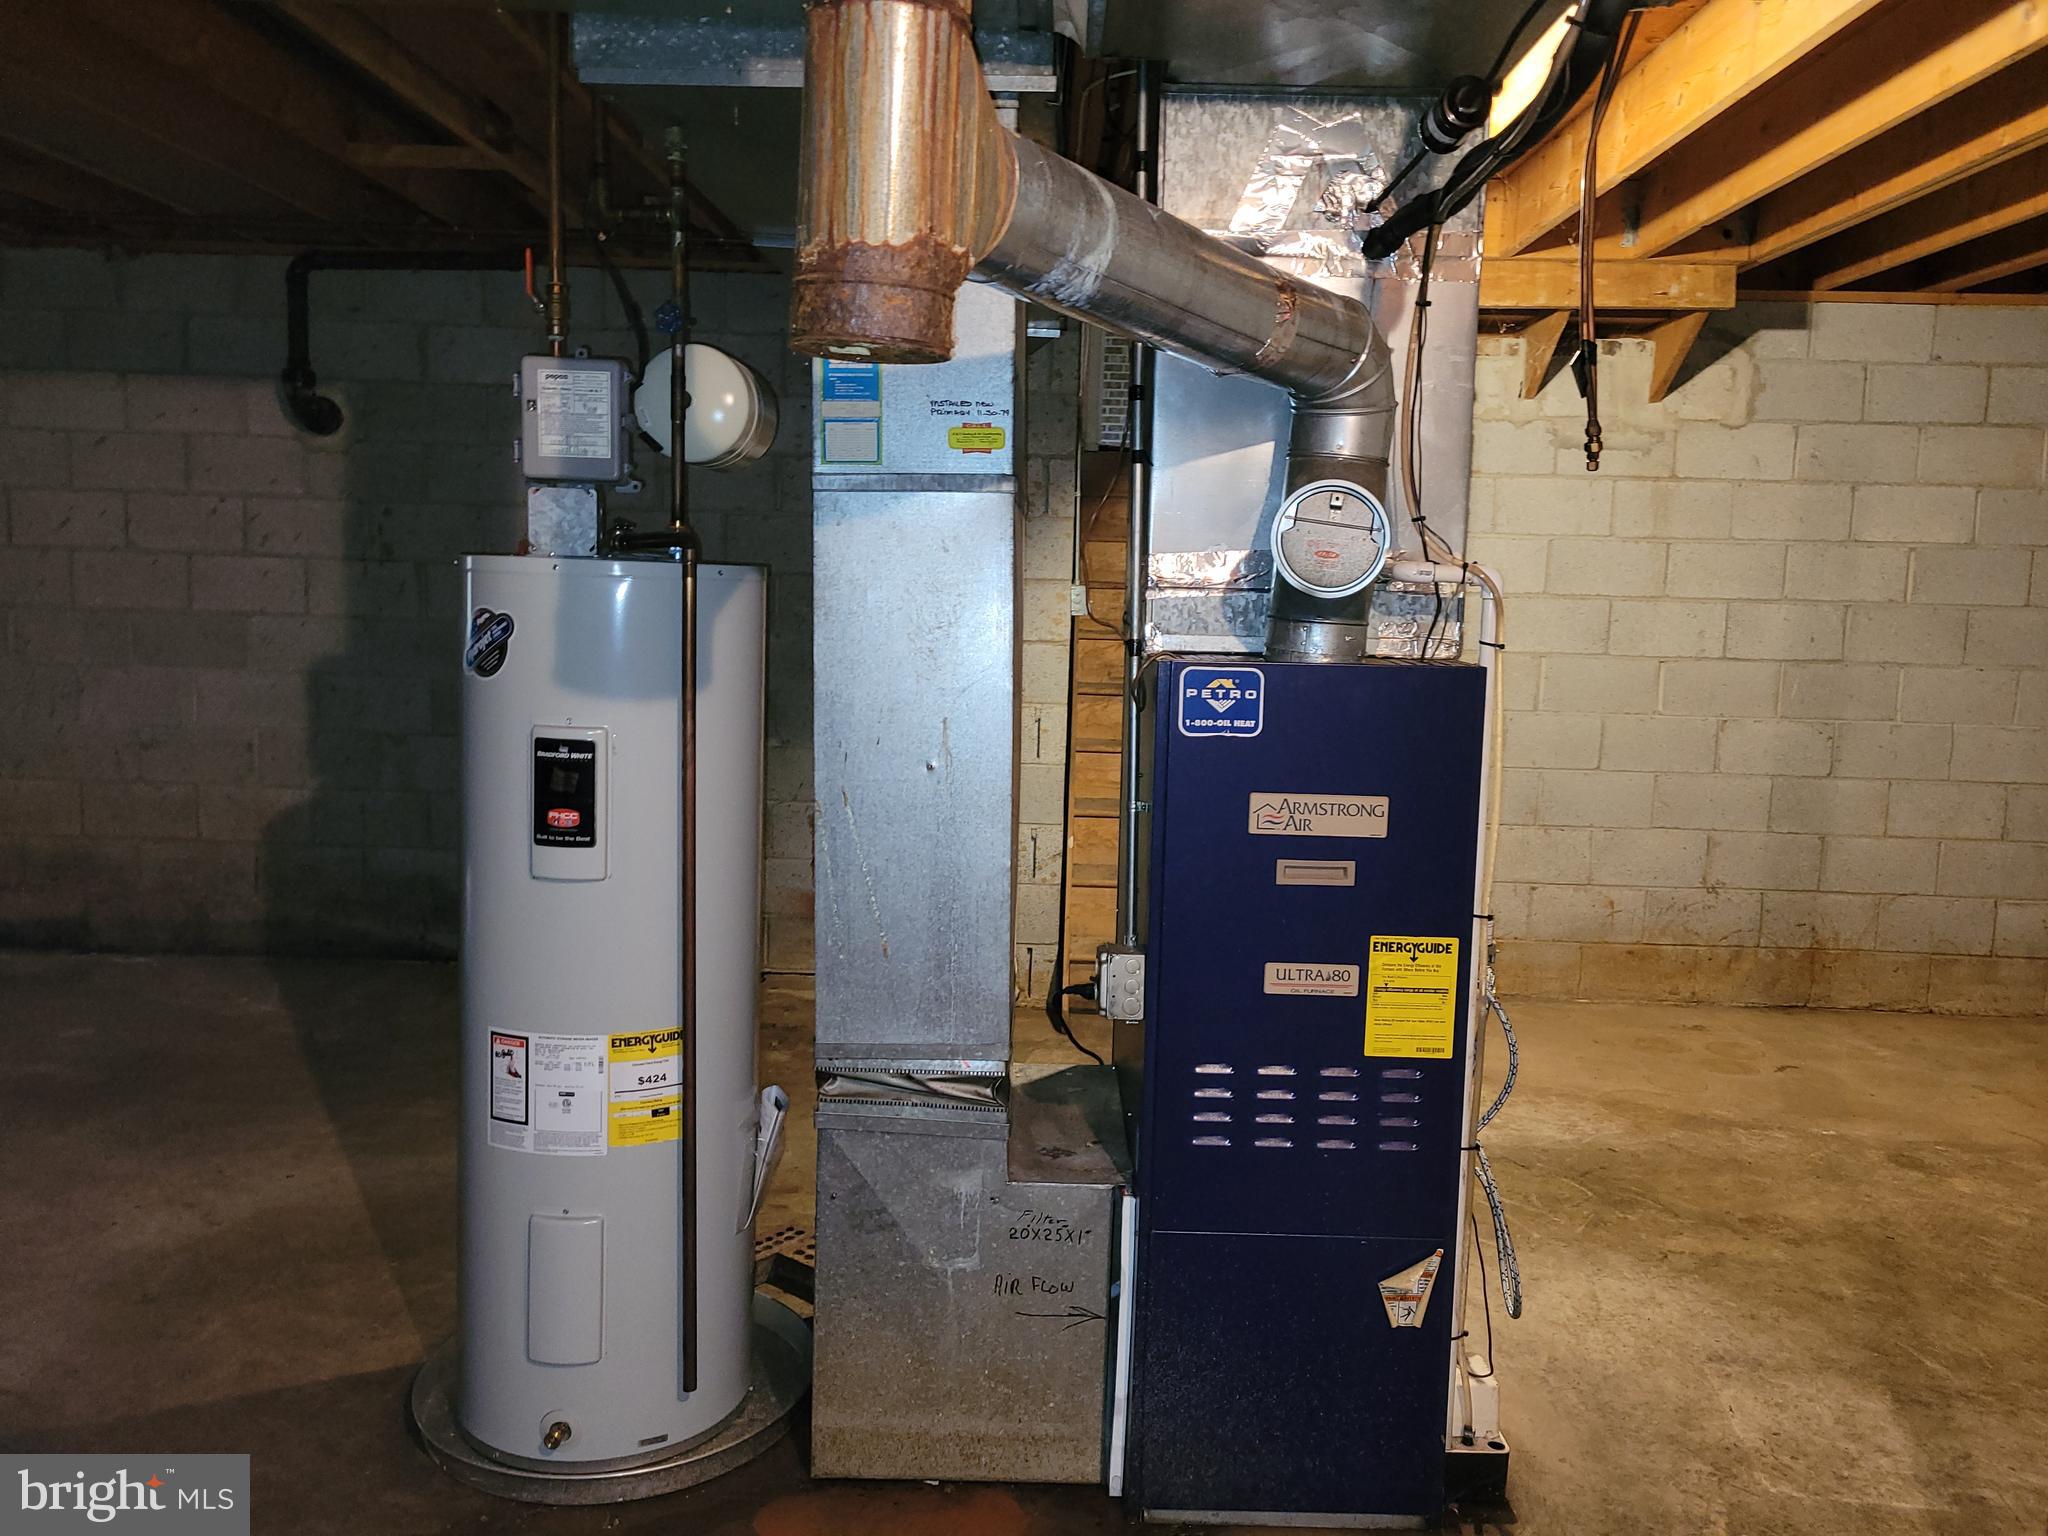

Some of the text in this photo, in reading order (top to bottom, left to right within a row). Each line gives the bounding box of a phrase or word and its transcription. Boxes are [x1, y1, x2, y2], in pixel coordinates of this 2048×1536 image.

[1185, 688, 1258, 699] PETRO
[1185, 719, 1256, 728] 1-800-OIL HEAT
[570, 752, 593, 760] WHITE
[1277, 798, 1385, 818] ARMSTRONG
[1282, 815, 1313, 831] AIR
[1373, 941, 1453, 954] ENERGYGUIDE
[1276, 968, 1351, 982] ULTRA 80
[638, 1073, 667, 1086] $424
